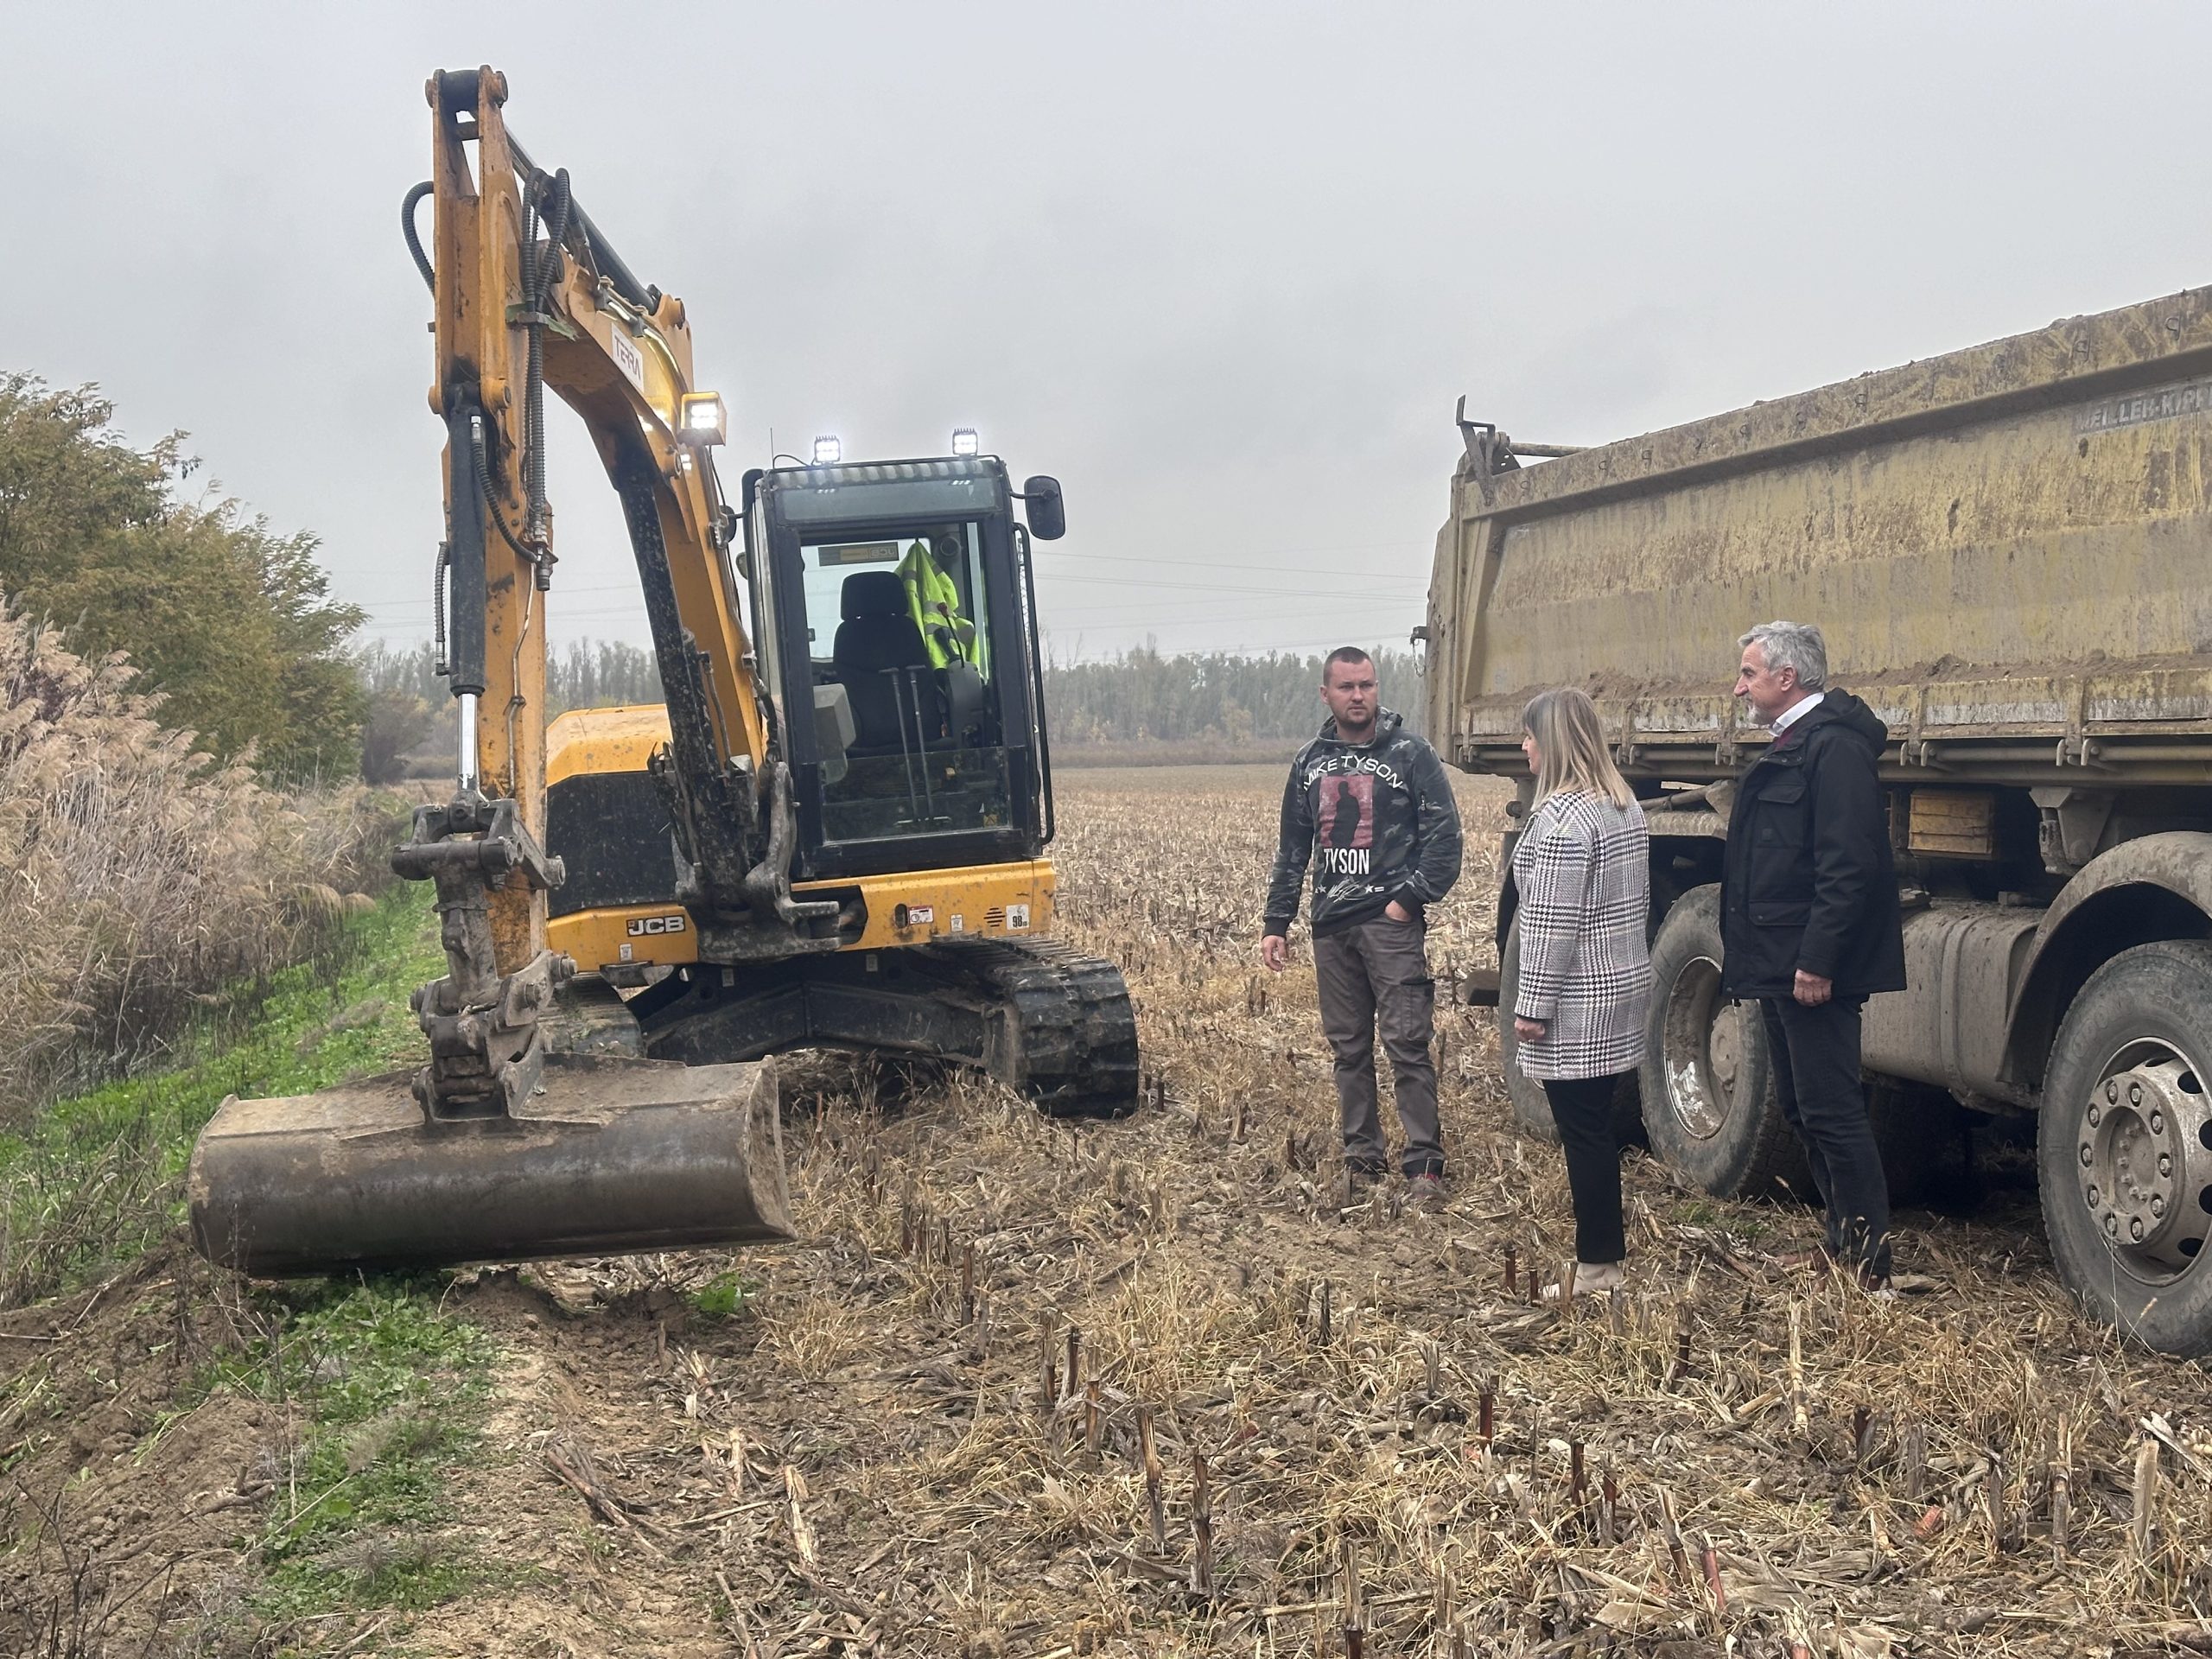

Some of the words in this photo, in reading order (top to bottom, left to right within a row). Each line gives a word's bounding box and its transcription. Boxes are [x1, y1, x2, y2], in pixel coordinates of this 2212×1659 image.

[614, 334, 641, 381] TERRA
[1304, 758, 1338, 791] MIKE
[1341, 755, 1403, 789] TYSON
[1324, 848, 1370, 874] TYSON
[627, 916, 684, 936] JCB
[1013, 915, 1023, 927] 98
